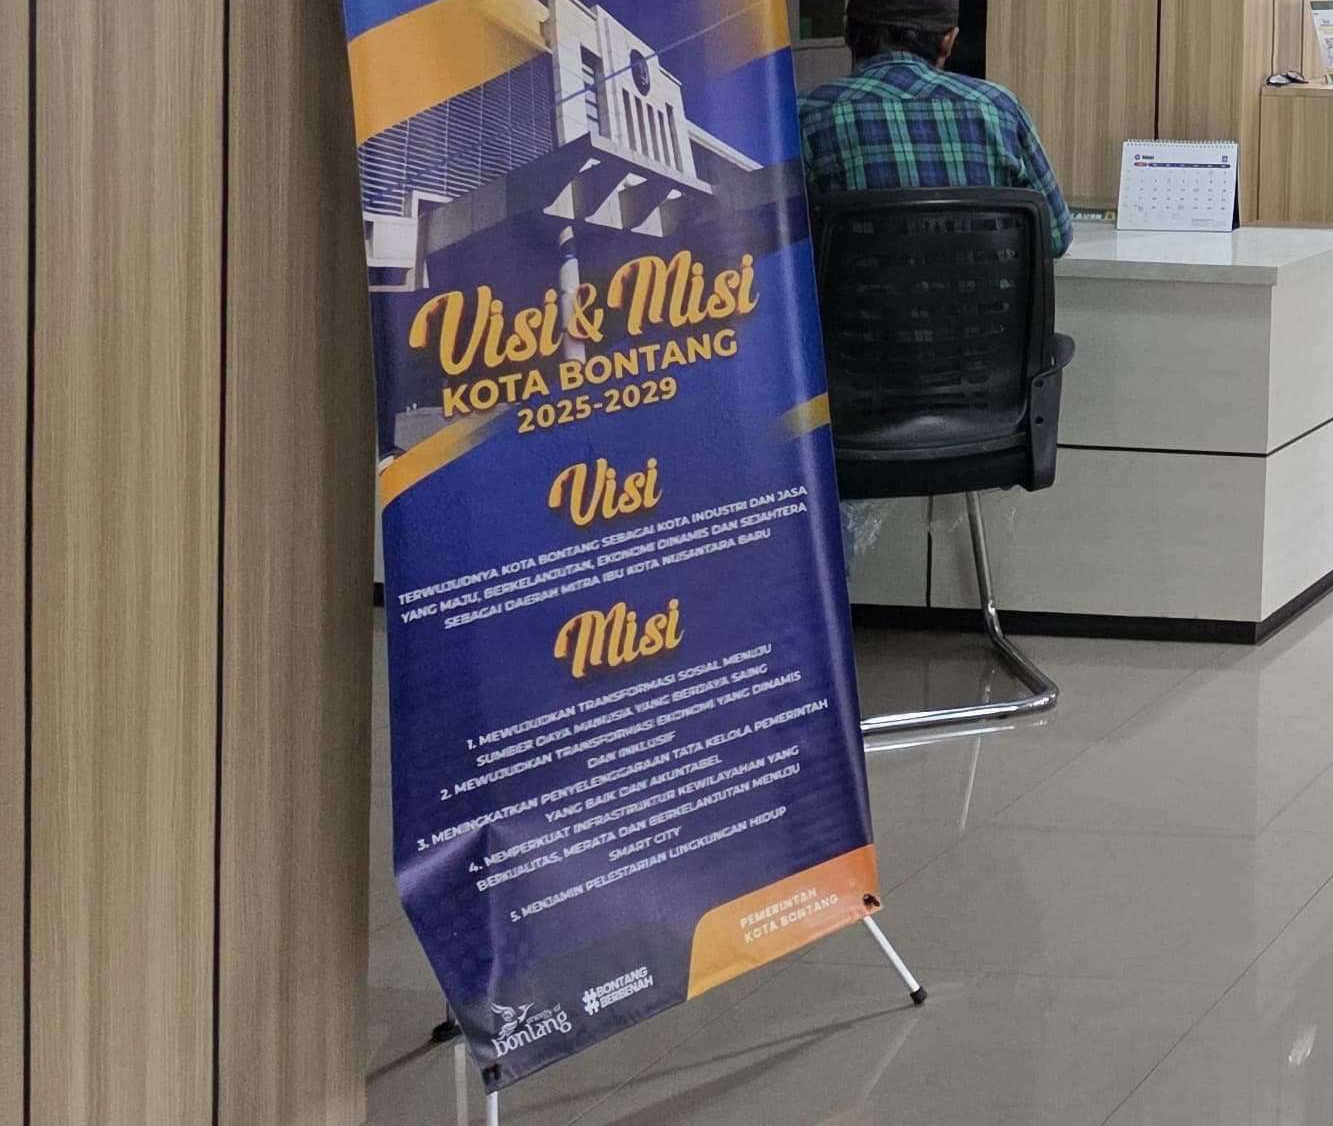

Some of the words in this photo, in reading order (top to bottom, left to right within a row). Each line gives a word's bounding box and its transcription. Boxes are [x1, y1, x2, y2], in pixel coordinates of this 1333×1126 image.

[408, 285, 565, 376] Visi
[567, 282, 605, 343] &
[607, 249, 761, 336] Misi
[442, 369, 549, 418] KOTA
[559, 328, 738, 391] BONTANG
[517, 376, 678, 435] 2025-2029
[548, 457, 664, 526] Visi
[398, 568, 499, 605] TERWUJUDNYA
[501, 559, 537, 576] KOTA
[537, 539, 600, 566] BONTANG
[601, 526, 656, 548] SEBAGAI
[657, 516, 690, 534] KOTA
[691, 500, 749, 524] INDUSTRI
[749, 493, 776, 509] DAN
[777, 485, 808, 501] JASA
[401, 605, 438, 624] YANG
[440, 590, 482, 614] MAJU,
[483, 558, 596, 600] BERKELANJUTAN,
[597, 541, 656, 567] EKONOMI
[657, 527, 710, 551] DINAMIS
[711, 519, 738, 535] DAN
[739, 502, 808, 528] SEJAHTERA
[443, 603, 503, 629] SEBAGAI
[504, 588, 560, 613] DAERAH
[561, 575, 601, 595] MITRA
[602, 567, 625, 583] IBU
[627, 557, 660, 576] KOTA
[661, 537, 737, 565] NUSANTARA
[737, 528, 771, 545] BARU
[554, 598, 686, 678] Misi
[440, 788, 453, 801] 2.
[454, 752, 553, 795] MEWUJUDKAN
[555, 718, 655, 760] TRANSFORMASI
[656, 699, 716, 727] EKONOMI
[716, 686, 750, 706] YANG
[752, 670, 802, 695] DINAMIS
[466, 738, 477, 750] 1.
[478, 705, 576, 746] MEWUJUDKAN
[577, 676, 676, 713] TRANSFORMASI
[676, 660, 722, 682] SOSIAL
[722, 643, 772, 667] MENUJU
[476, 739, 535, 767] SUMBER
[535, 726, 572, 747] DAYA
[573, 707, 634, 734] MANUSIA
[633, 694, 671, 714] YANG
[671, 675, 730, 702] BERDAYA
[730, 663, 768, 683] SAING
[417, 838, 430, 852] 3.
[431, 796, 538, 846] MENINGKATKAN
[540, 752, 670, 806] PENYELENGGARAAN
[672, 740, 704, 759] TATA
[704, 724, 754, 749] KELOLA
[753, 698, 829, 732] PEMERINTAH
[468, 861, 483, 874] 4.
[484, 825, 571, 867] MEMPERKUAT
[573, 789, 676, 834] INFRASTRUKTUR
[677, 757, 766, 797] KEWILAYAHAN
[766, 744, 800, 764] YANG
[544, 801, 584, 823] YANG
[585, 789, 617, 810] BAIK
[618, 778, 648, 798] DAN
[649, 754, 724, 791] AKUNTABEL
[587, 751, 617, 769] DAN
[476, 851, 564, 892] BERKUALITAS,
[563, 831, 618, 858] MERATA
[618, 819, 648, 838] DAN
[649, 782, 750, 826] BERKELANJUTAN
[751, 763, 801, 789] MENUJU
[509, 910, 523, 923] 5.
[521, 884, 585, 918] MENJAMIN
[585, 850, 668, 892] PELESTARIAN
[669, 820, 748, 859] LINGKUNGAN
[749, 805, 788, 828] HIDUP
[608, 837, 653, 862] SMART
[653, 825, 683, 844] CITY
[740, 886, 817, 929] PEMERINTAH
[743, 920, 779, 945] KOTA
[780, 893, 839, 927] BONTANG
[599, 975, 654, 1009] BERBENAH
